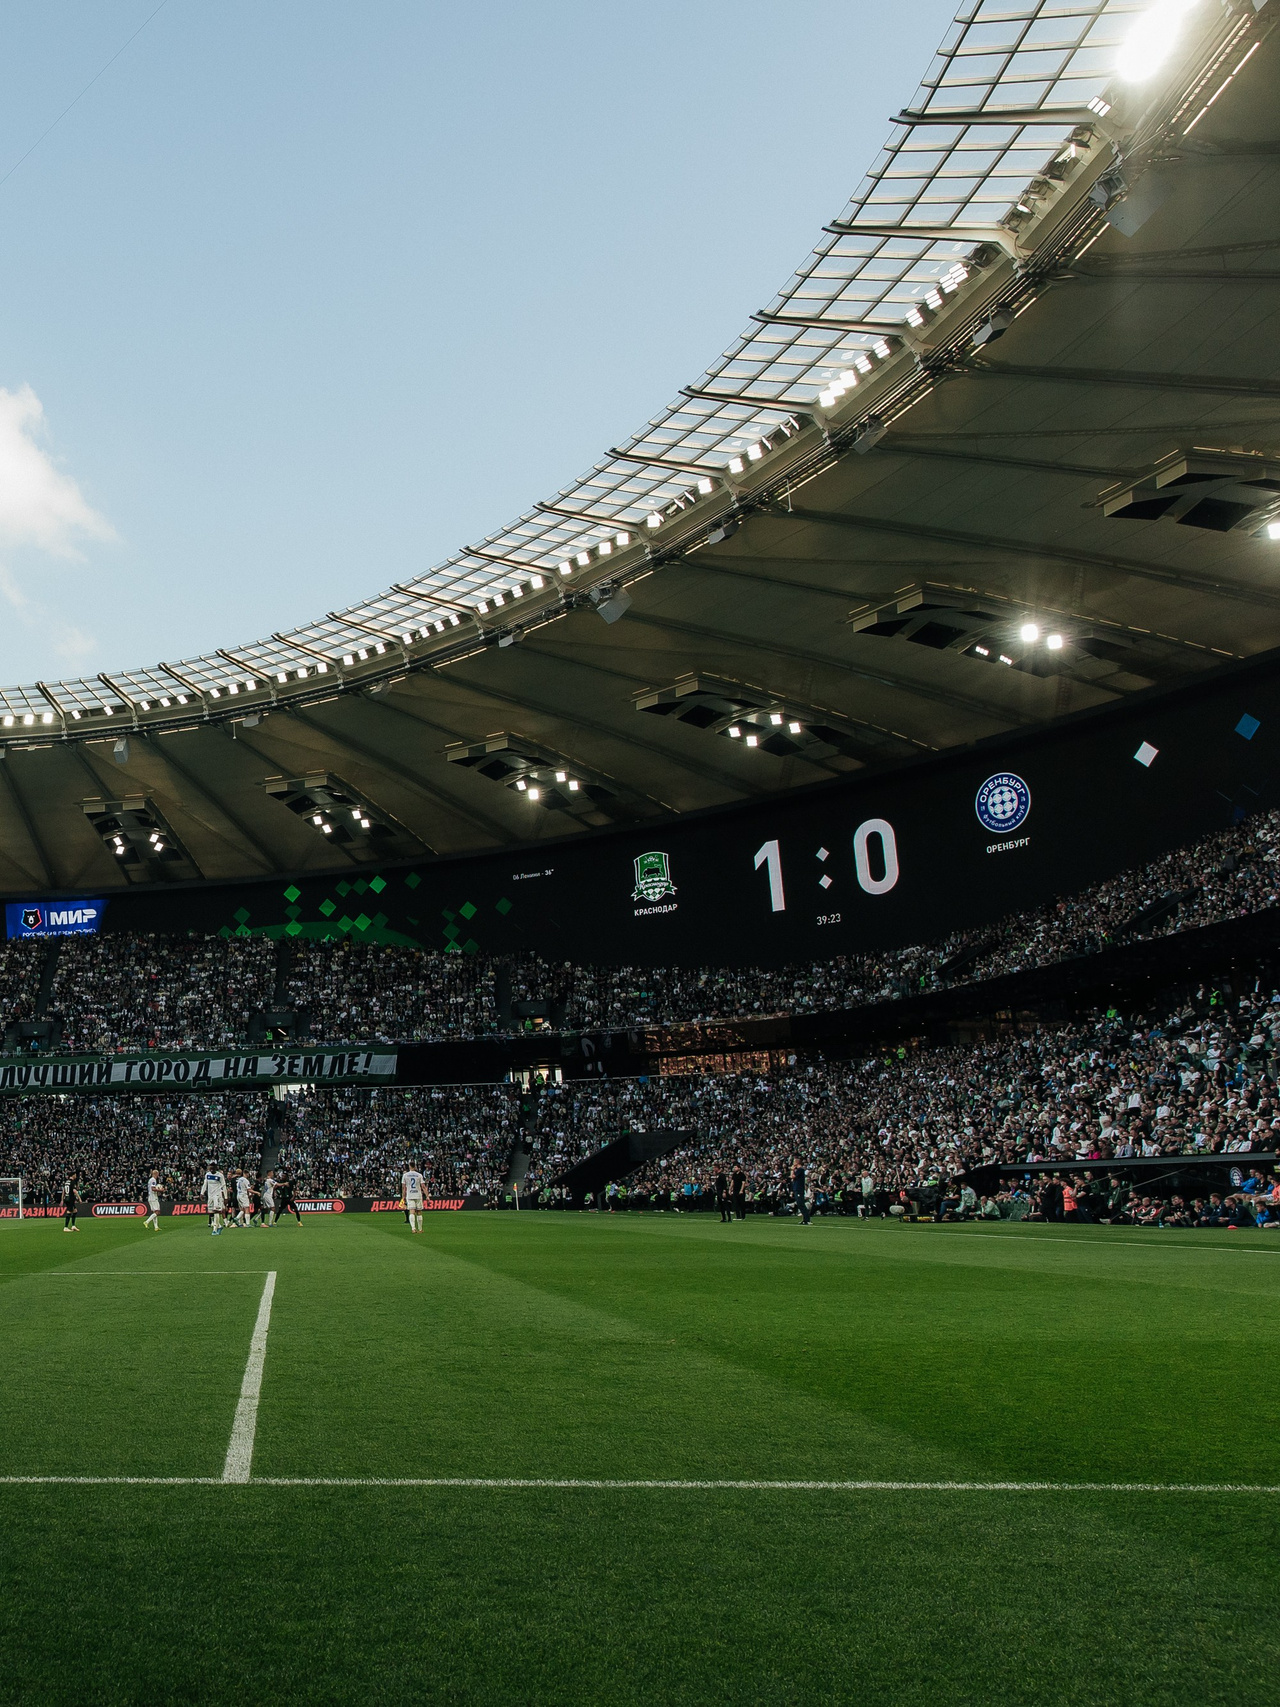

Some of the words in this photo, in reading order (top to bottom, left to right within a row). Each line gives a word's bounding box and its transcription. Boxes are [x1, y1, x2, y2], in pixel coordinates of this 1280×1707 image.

[980, 777, 1025, 803] ОРЕНБУРГ
[986, 837, 1030, 854] ОРЕНБУРГ
[49, 908, 97, 926] МИР
[634, 903, 678, 917] КРАСНОДАР
[816, 913, 842, 926] 39:23
[124, 1058, 212, 1089] ГОРОД
[222, 1055, 260, 1079] НА
[270, 1050, 375, 1080] ЗЕМЛЕ!
[410, 1177, 416, 1189] 2
[22, 1206, 67, 1218] РАЗНИЦУ
[95, 1205, 135, 1215] WINLINE
